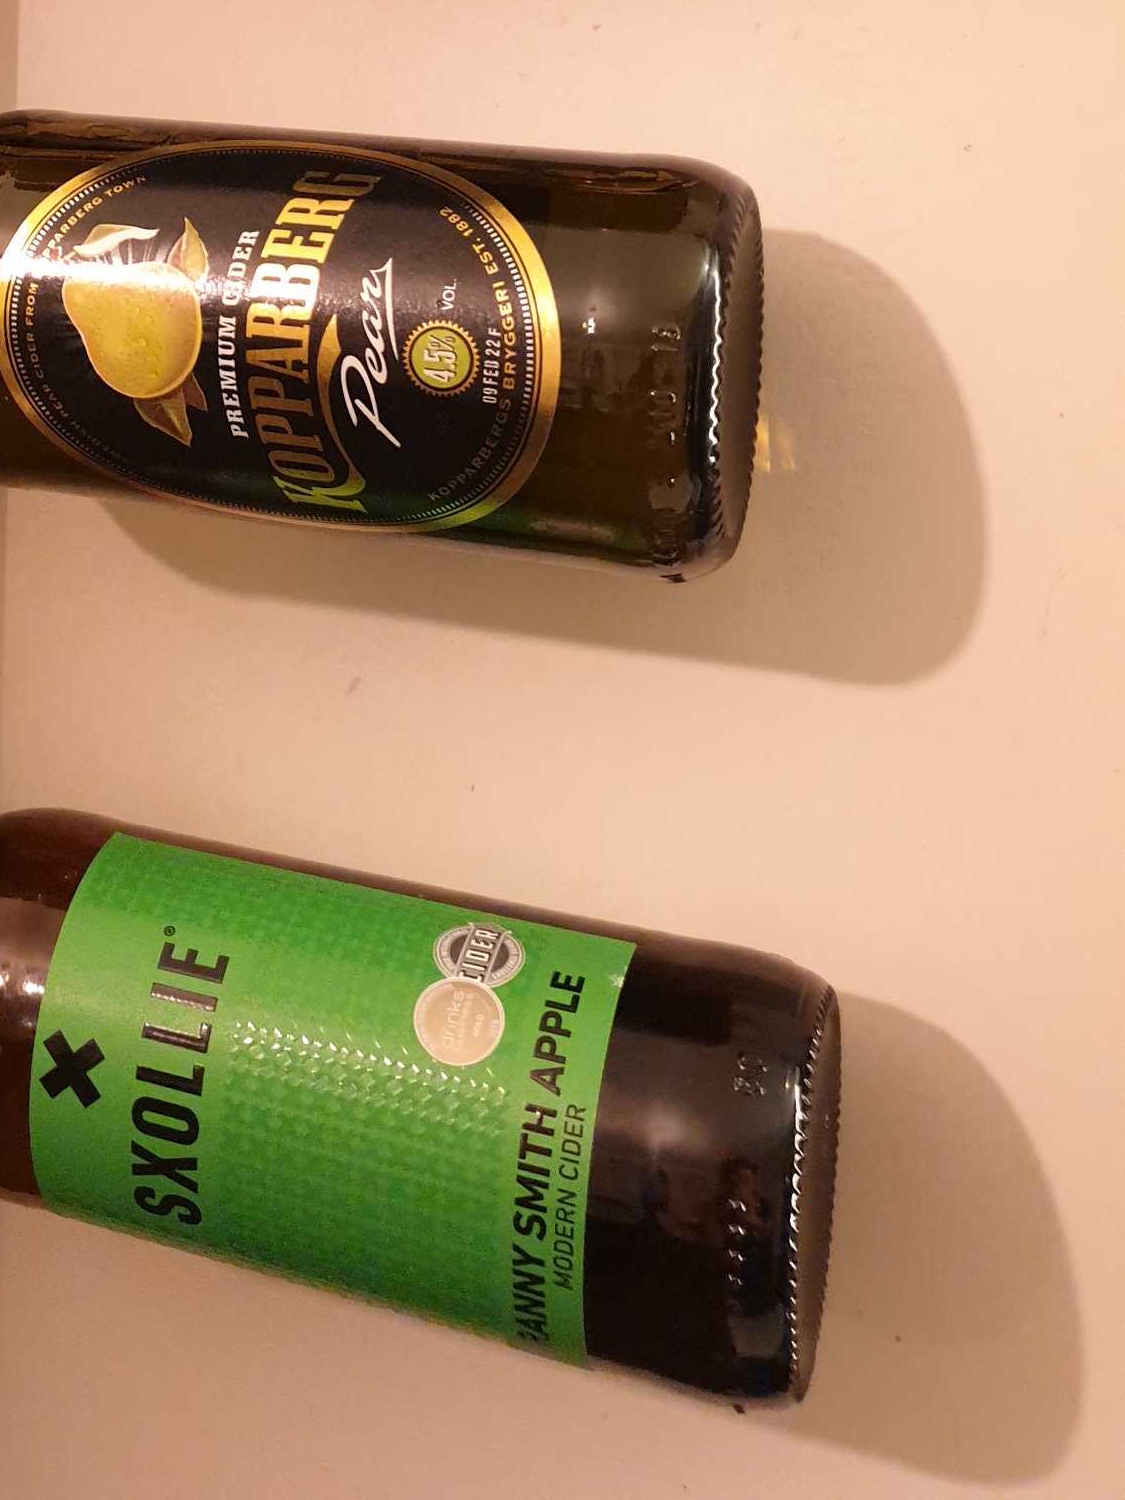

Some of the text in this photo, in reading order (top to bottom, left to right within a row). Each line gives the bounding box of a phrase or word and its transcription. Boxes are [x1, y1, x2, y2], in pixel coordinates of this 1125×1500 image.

[105, 175, 147, 197] TOWN
[439, 206, 474, 237] 1882
[440, 278, 458, 310] VOL.
[471, 237, 499, 274] EST.
[25, 282, 39, 326] FROM
[218, 230, 259, 438] PREMIUM CIDER
[245, 170, 383, 513] KOPPARBERG
[492, 281, 517, 389] BRYGGERI
[25, 332, 45, 379] CIDER
[340, 258, 401, 447] Pear
[423, 334, 458, 384] 4.5%
[482, 327, 500, 404] 09 FEB 22 F
[41, 384, 69, 418] PEAR
[427, 400, 512, 500] KOPPARBERGS
[530, 970, 585, 1096] APPLE
[513, 1102, 557, 1241] SMITH
[552, 1103, 586, 1291] MODERN CIDER
